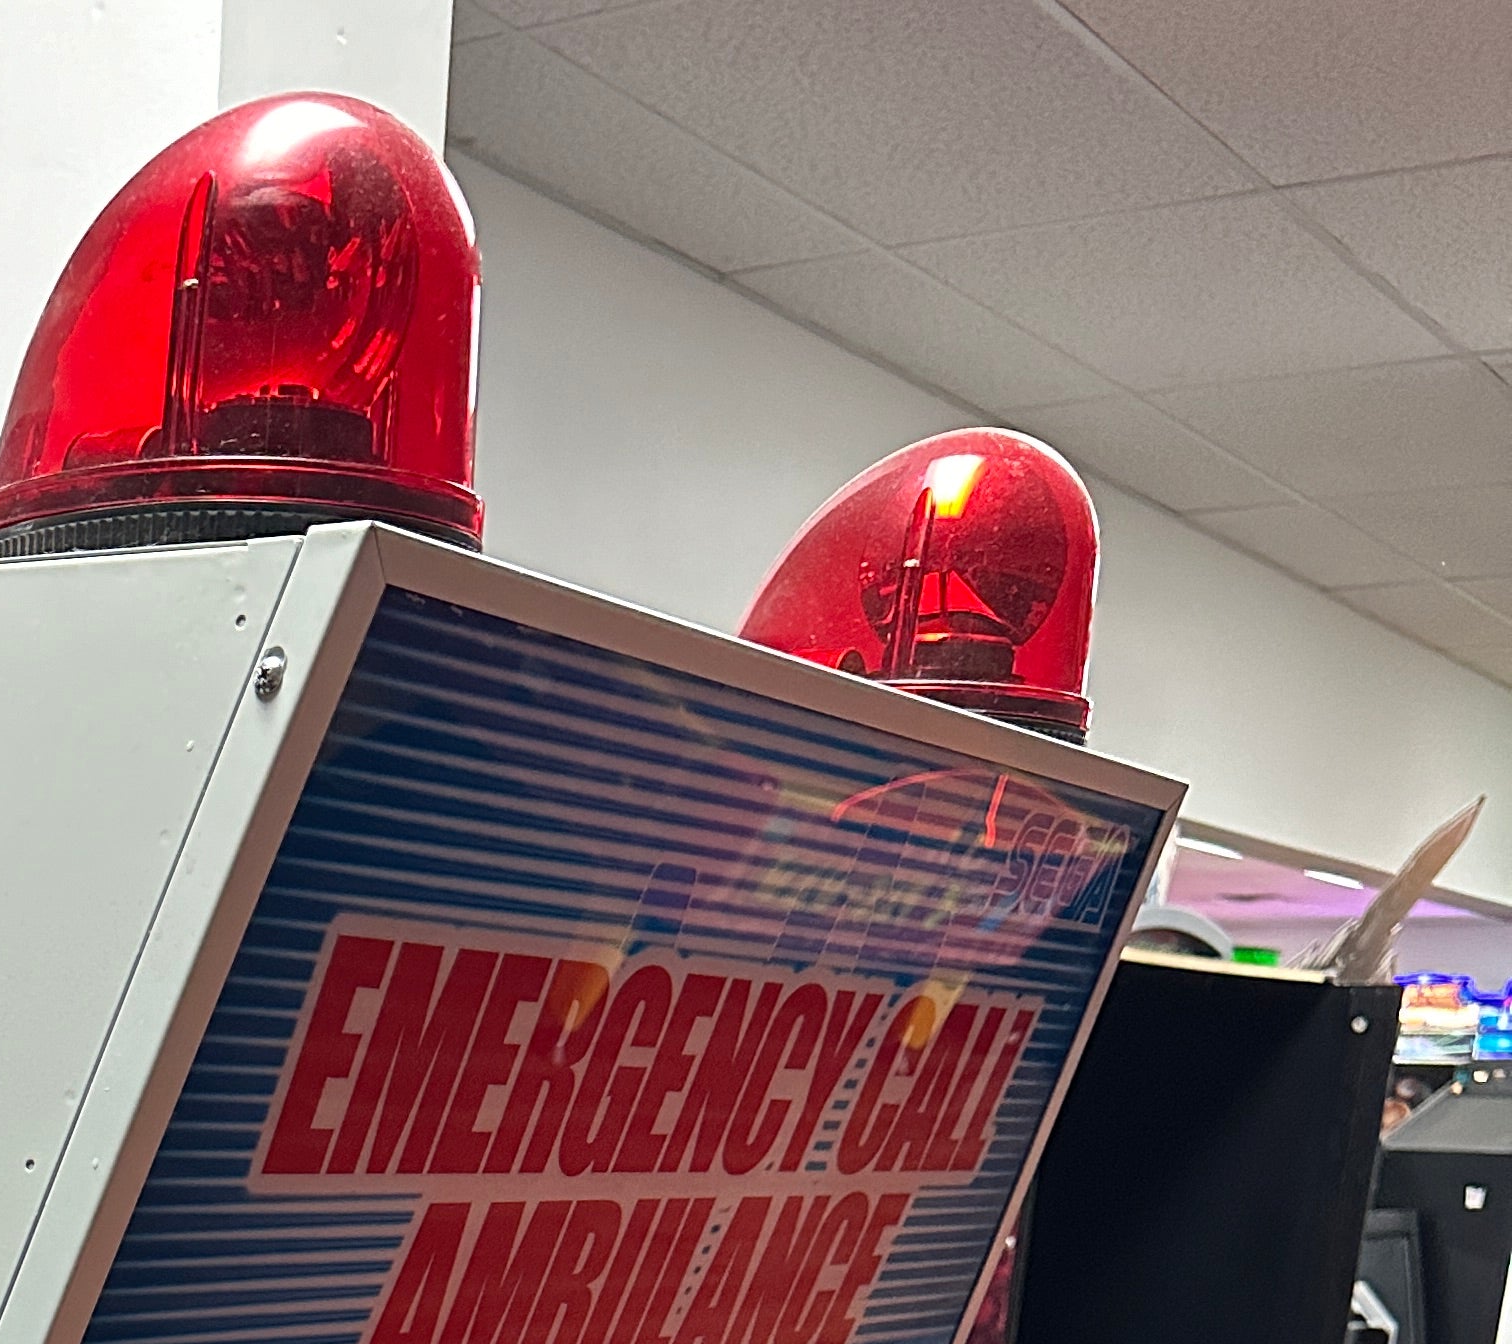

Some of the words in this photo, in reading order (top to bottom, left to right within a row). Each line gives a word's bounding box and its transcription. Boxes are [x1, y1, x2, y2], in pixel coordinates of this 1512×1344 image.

[988, 812, 1133, 934] SEGA
[261, 934, 884, 1177] EMERGENCY
[838, 998, 1040, 1174] CALL
